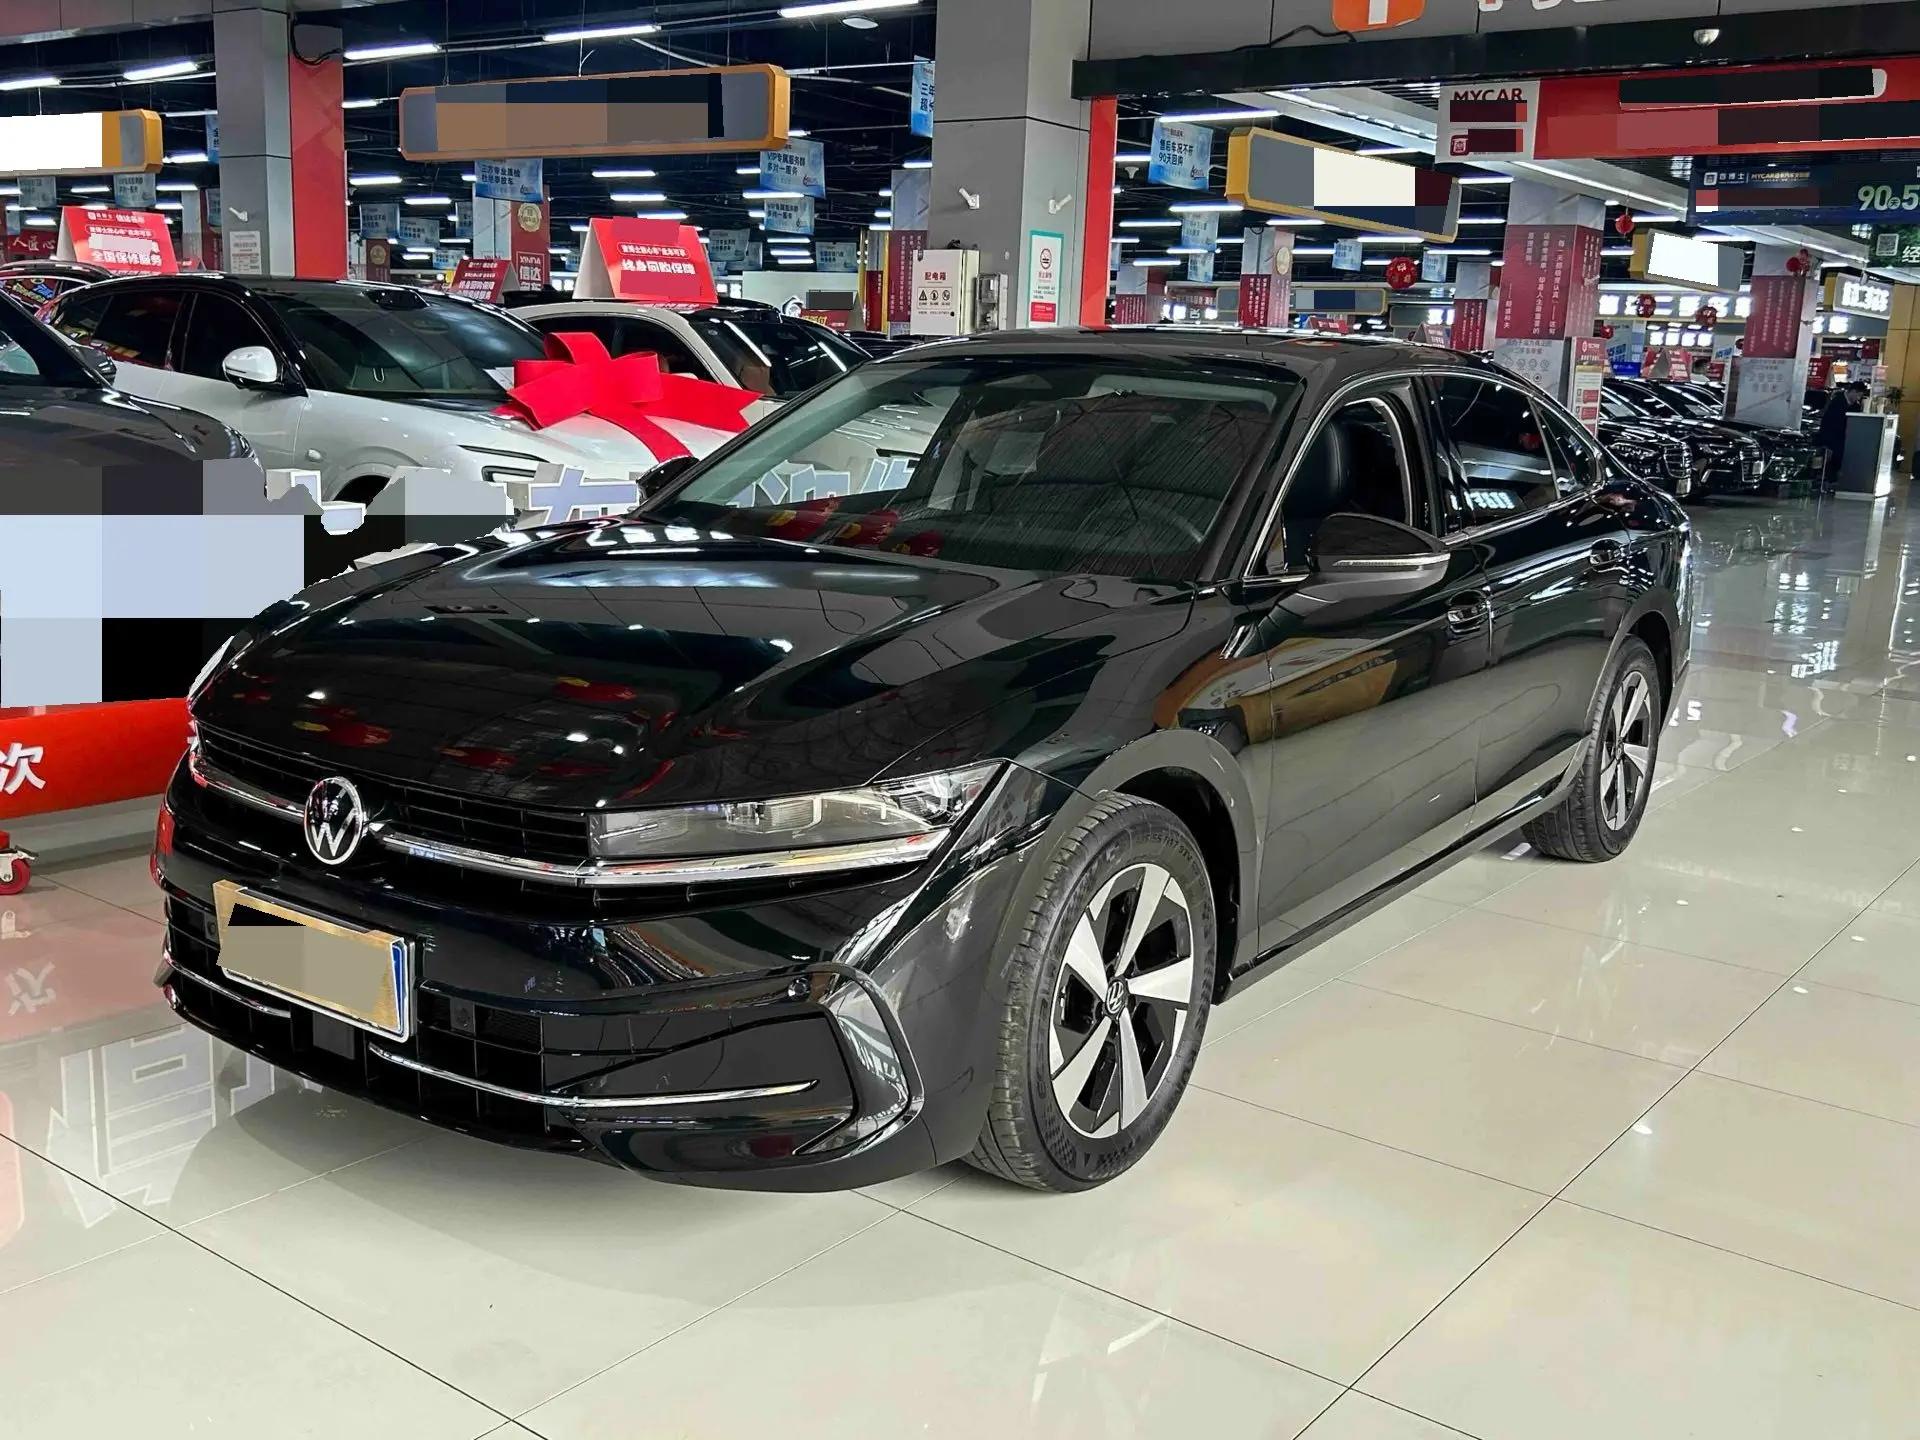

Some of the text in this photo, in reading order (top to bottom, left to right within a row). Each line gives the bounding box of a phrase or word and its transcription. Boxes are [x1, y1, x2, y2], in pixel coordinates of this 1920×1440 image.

[91, 250, 163, 267] 全国保修服务
[924, 271, 947, 281] 配电箱
